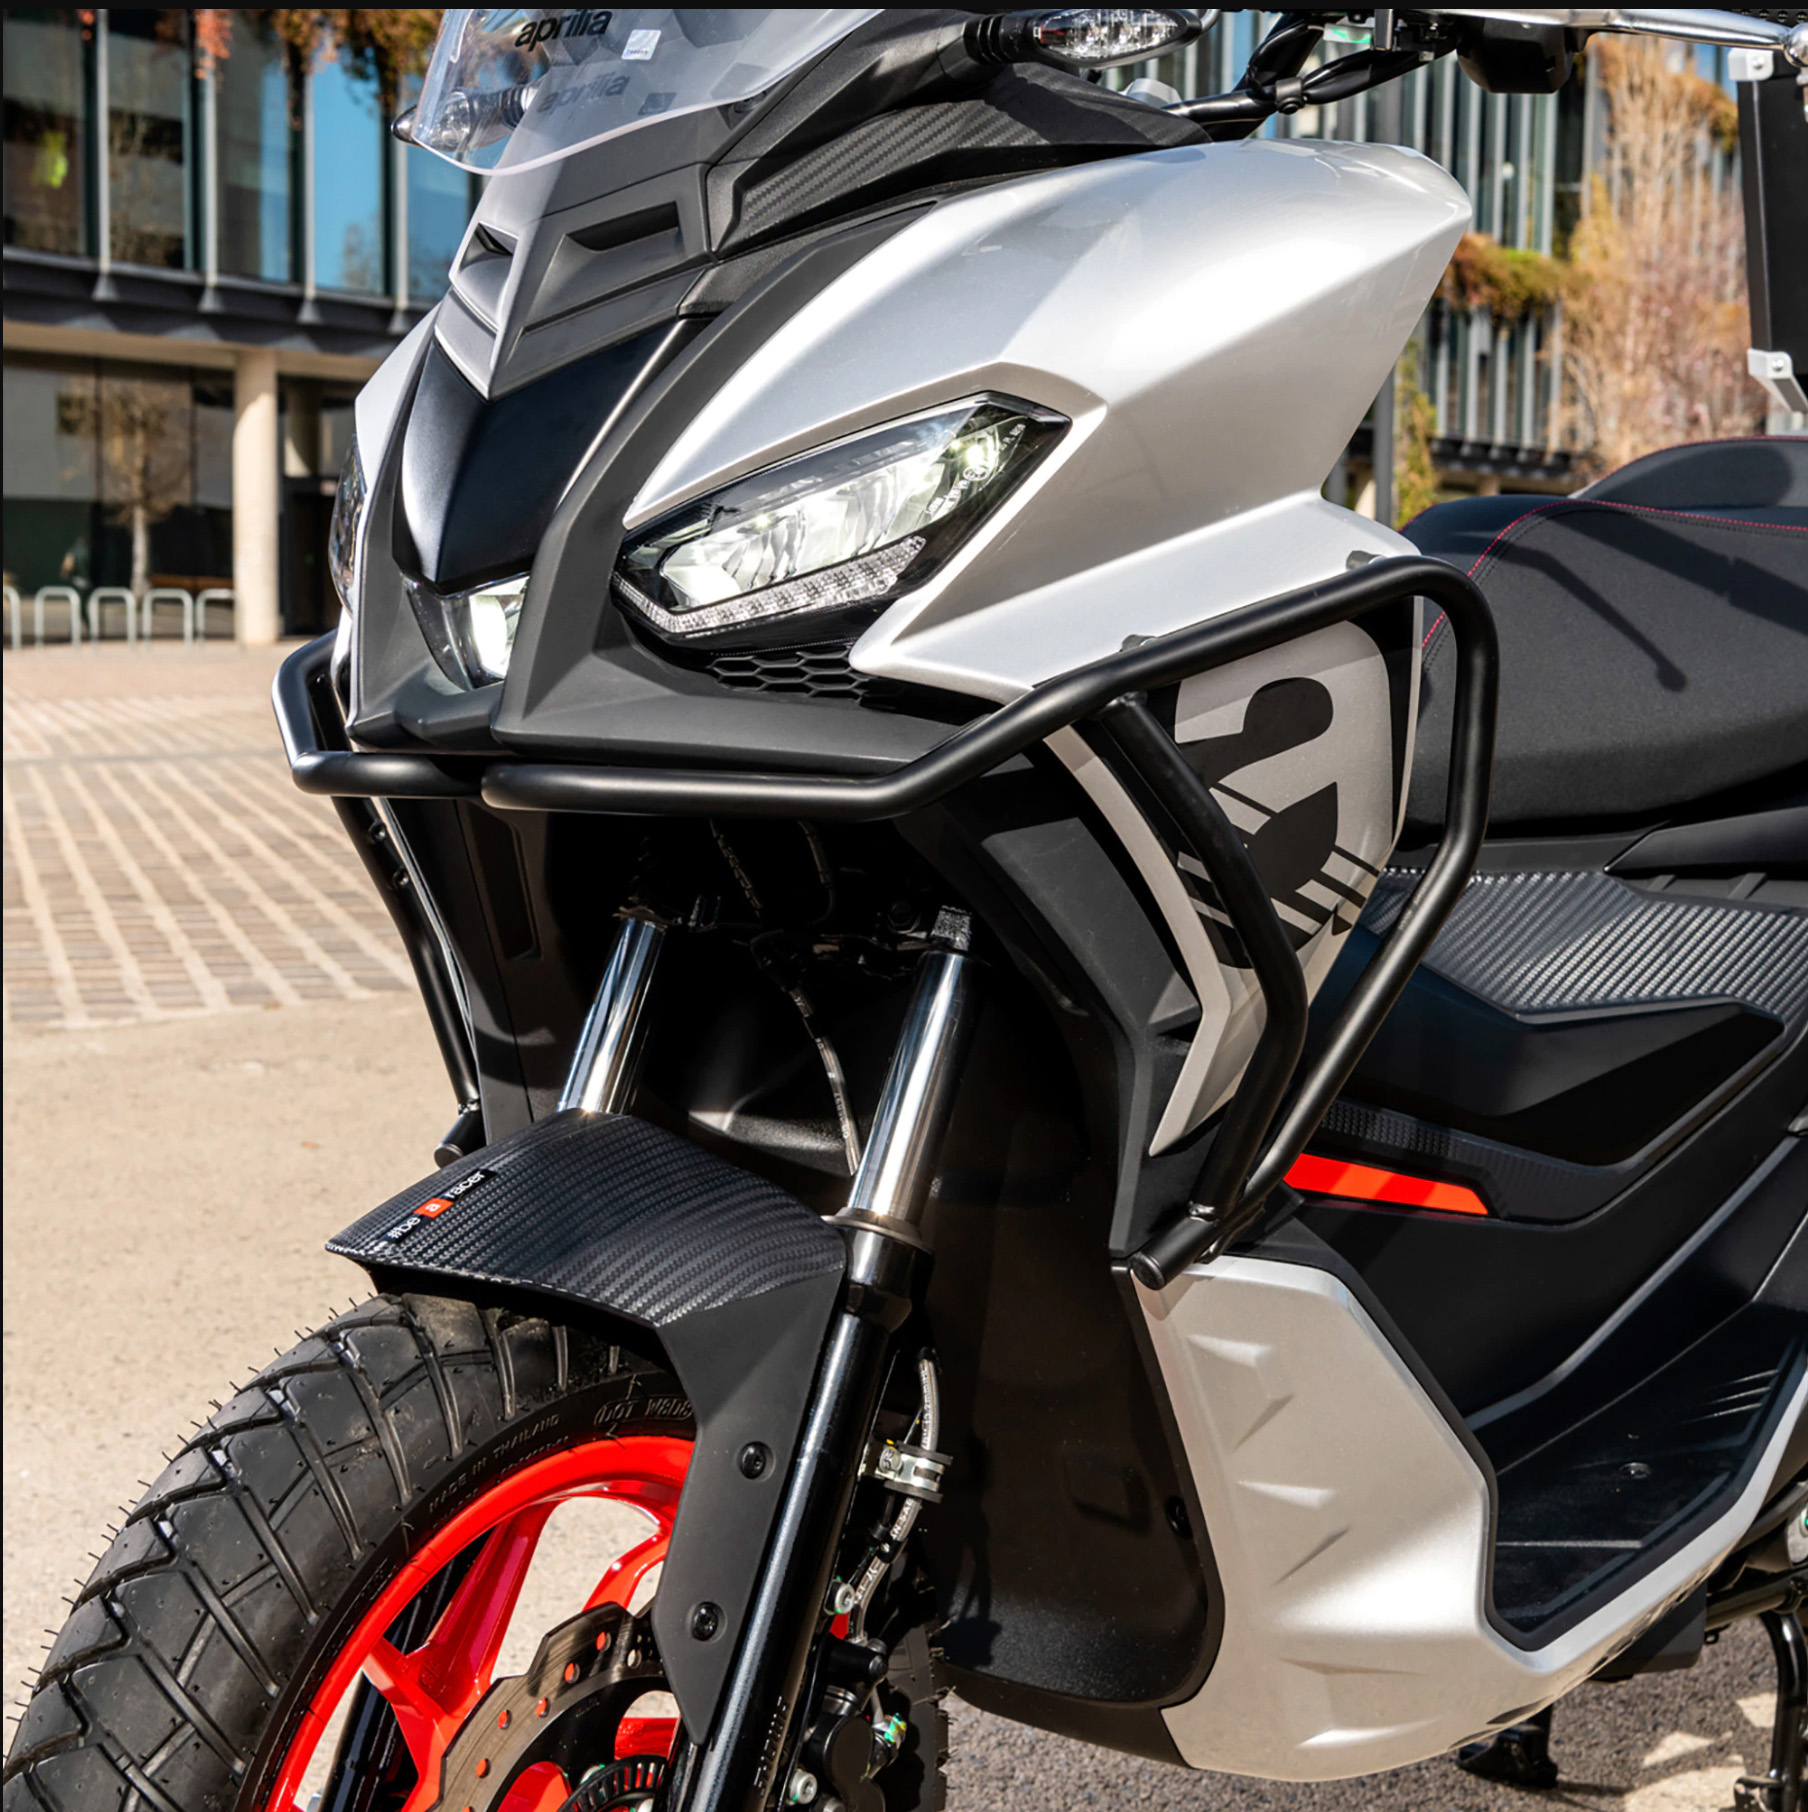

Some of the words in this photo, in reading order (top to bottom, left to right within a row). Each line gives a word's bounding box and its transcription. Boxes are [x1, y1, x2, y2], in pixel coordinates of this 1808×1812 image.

[515, 9, 612, 52] aprilia
[387, 1217, 421, 1240] #be
[445, 1170, 485, 1199] racer
[492, 1413, 560, 1459] THAILAND
